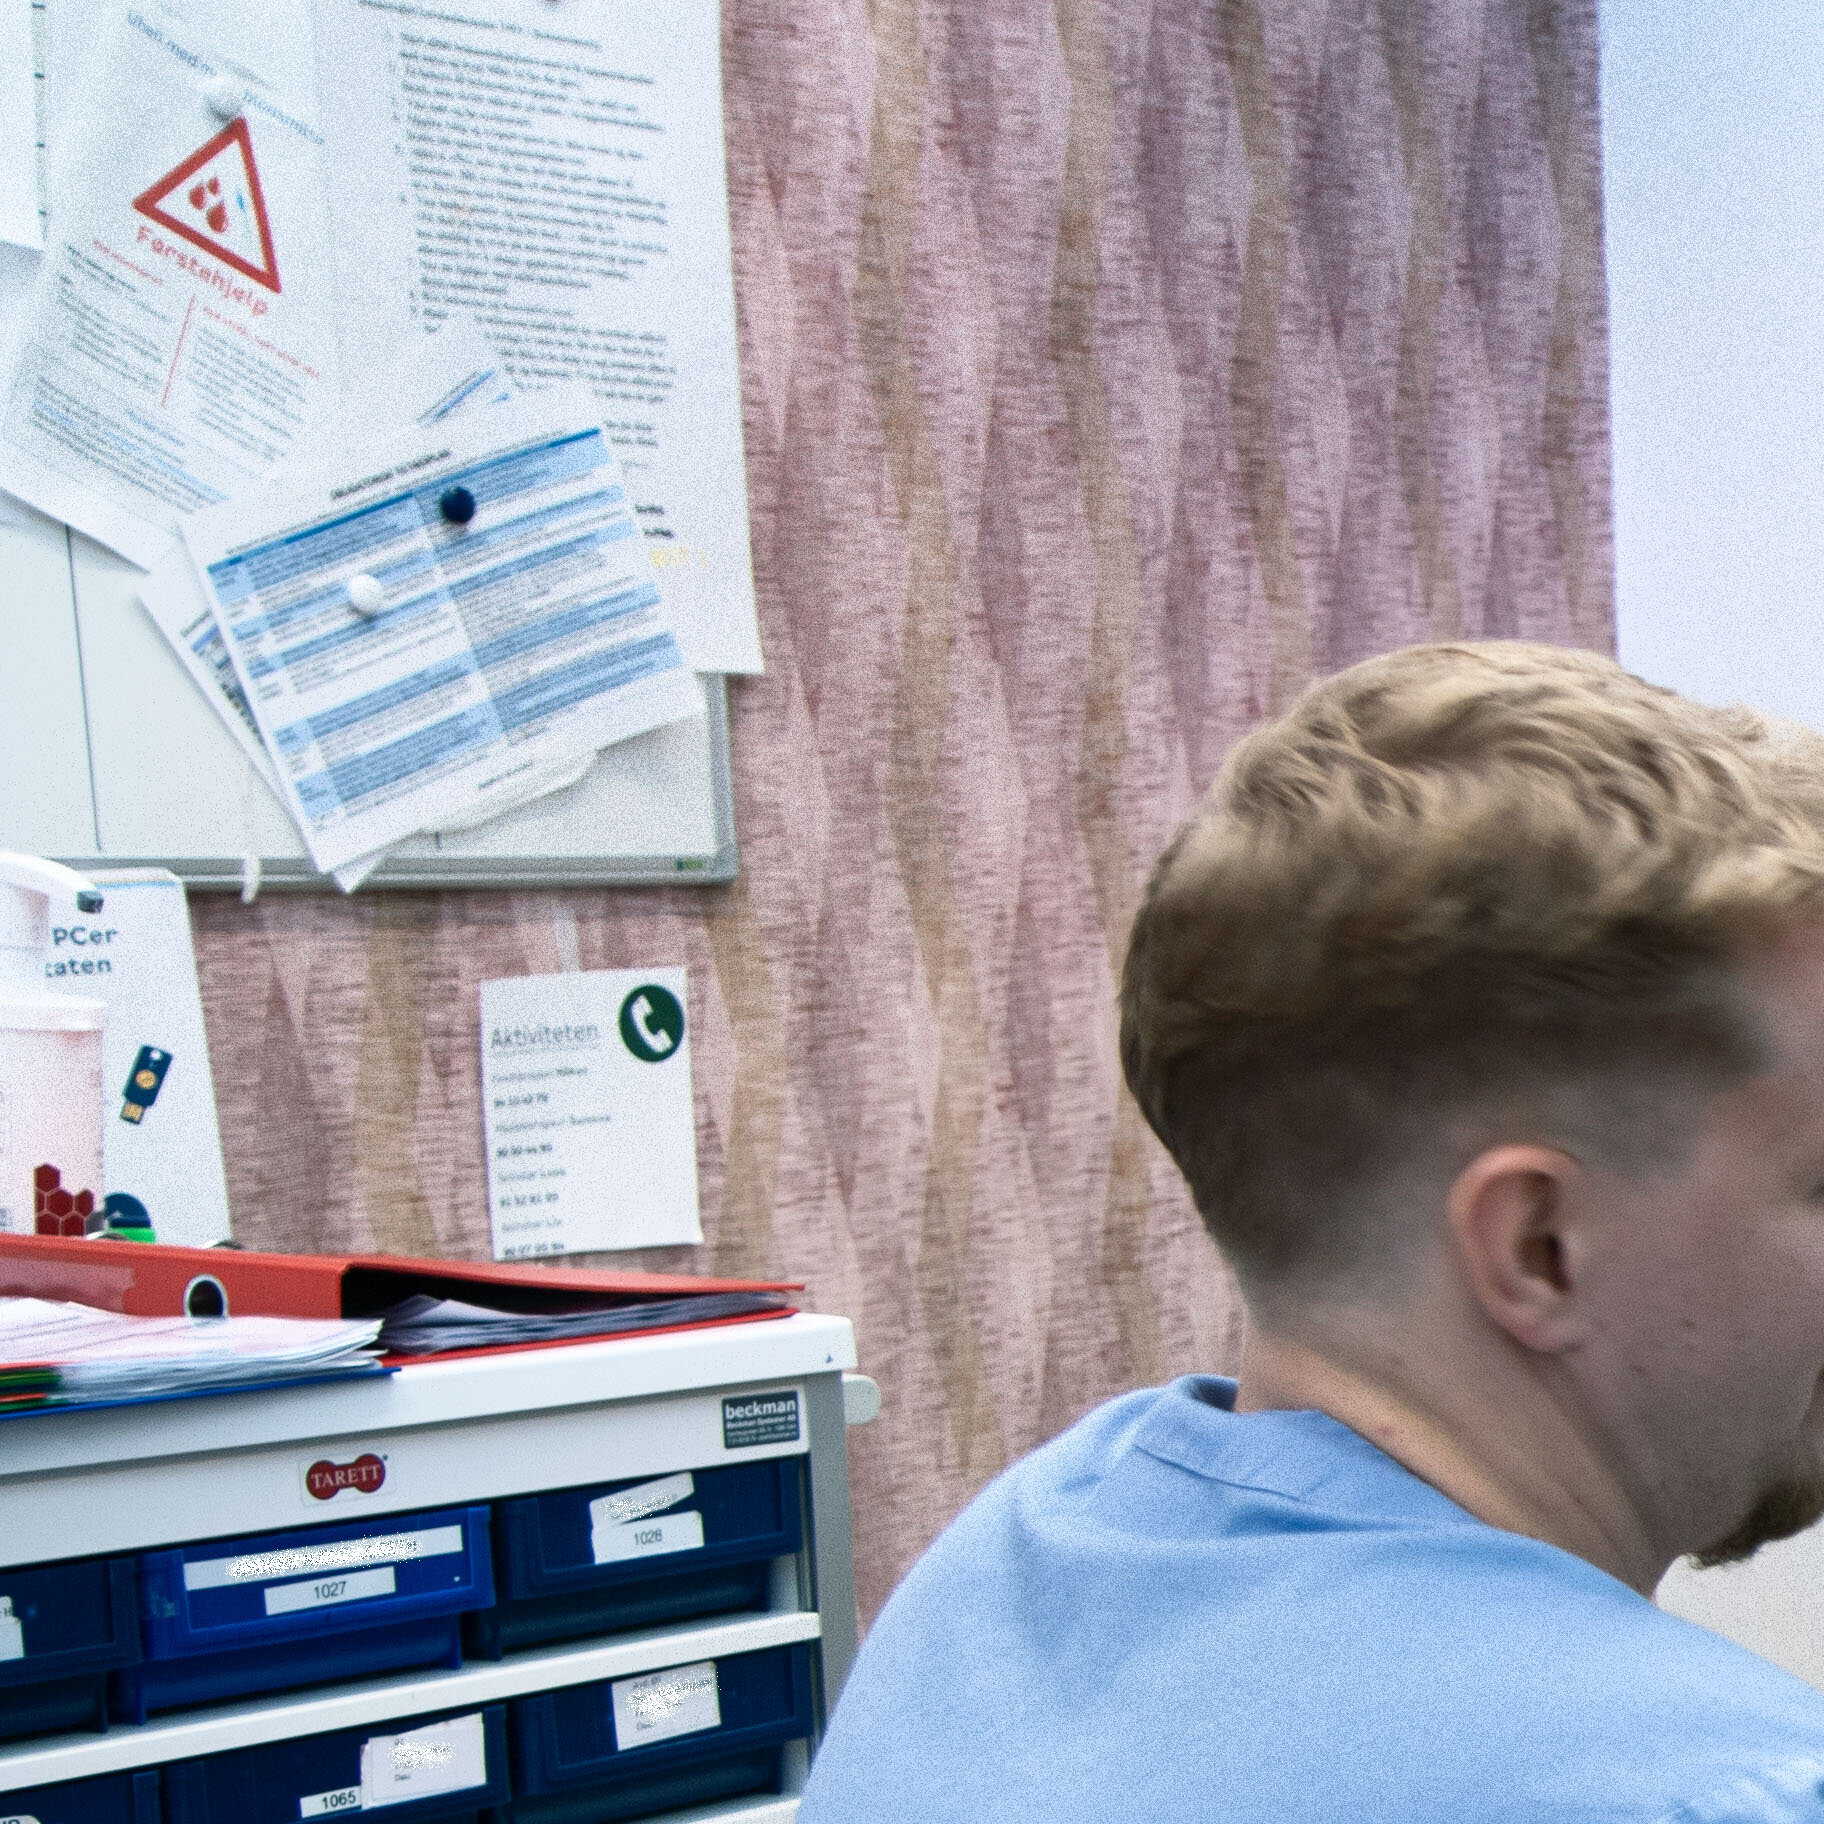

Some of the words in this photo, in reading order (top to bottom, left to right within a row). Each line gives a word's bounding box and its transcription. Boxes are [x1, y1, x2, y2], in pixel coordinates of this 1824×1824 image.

[52, 926, 118, 947] PCer
[725, 1400, 796, 1420] beckman
[310, 1463, 381, 1490] TARETT
[313, 1580, 348, 1600] 1027
[321, 1790, 357, 1810] 1065
